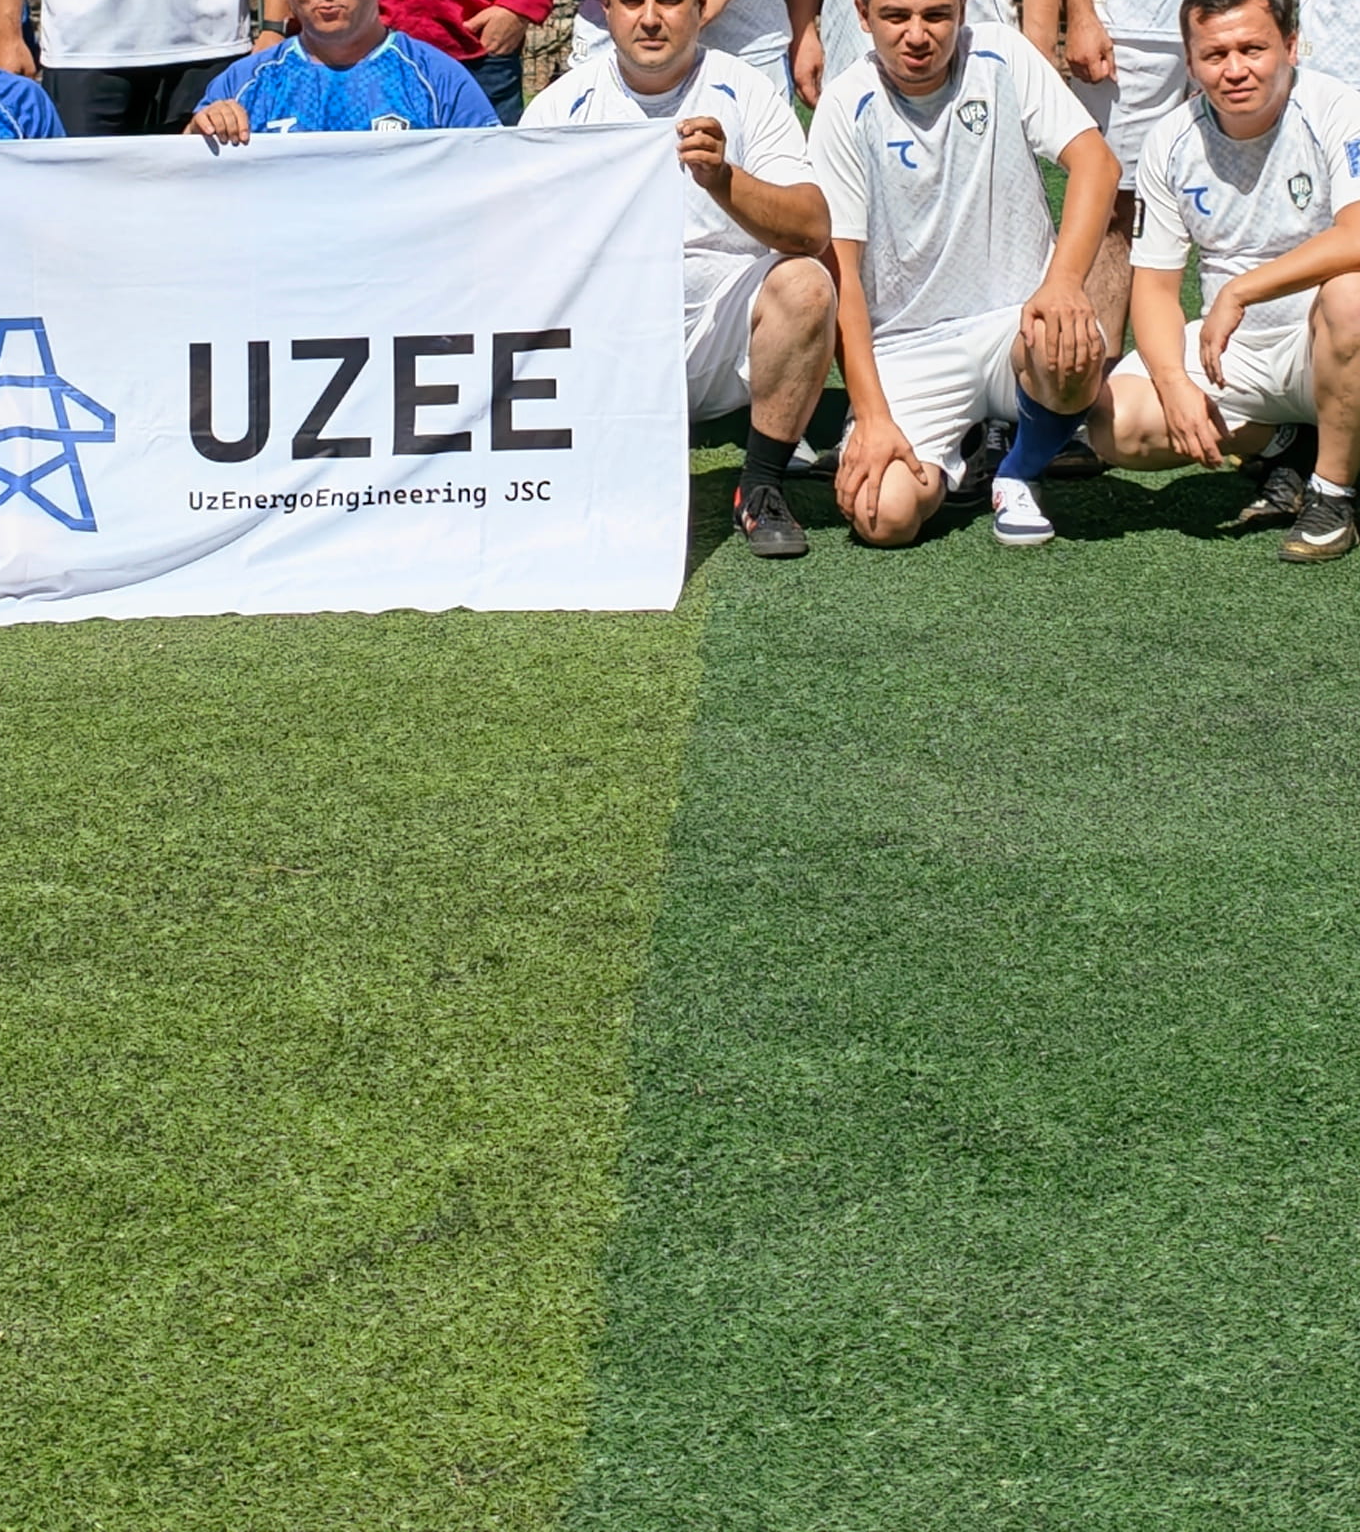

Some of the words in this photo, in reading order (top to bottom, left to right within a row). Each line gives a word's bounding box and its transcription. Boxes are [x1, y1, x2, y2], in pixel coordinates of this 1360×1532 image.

[959, 103, 986, 123] UFA
[1290, 178, 1312, 196] UFA
[189, 328, 573, 463] UZEE
[189, 487, 487, 514] UzEnergoEngineering
[504, 480, 551, 502] JSC
